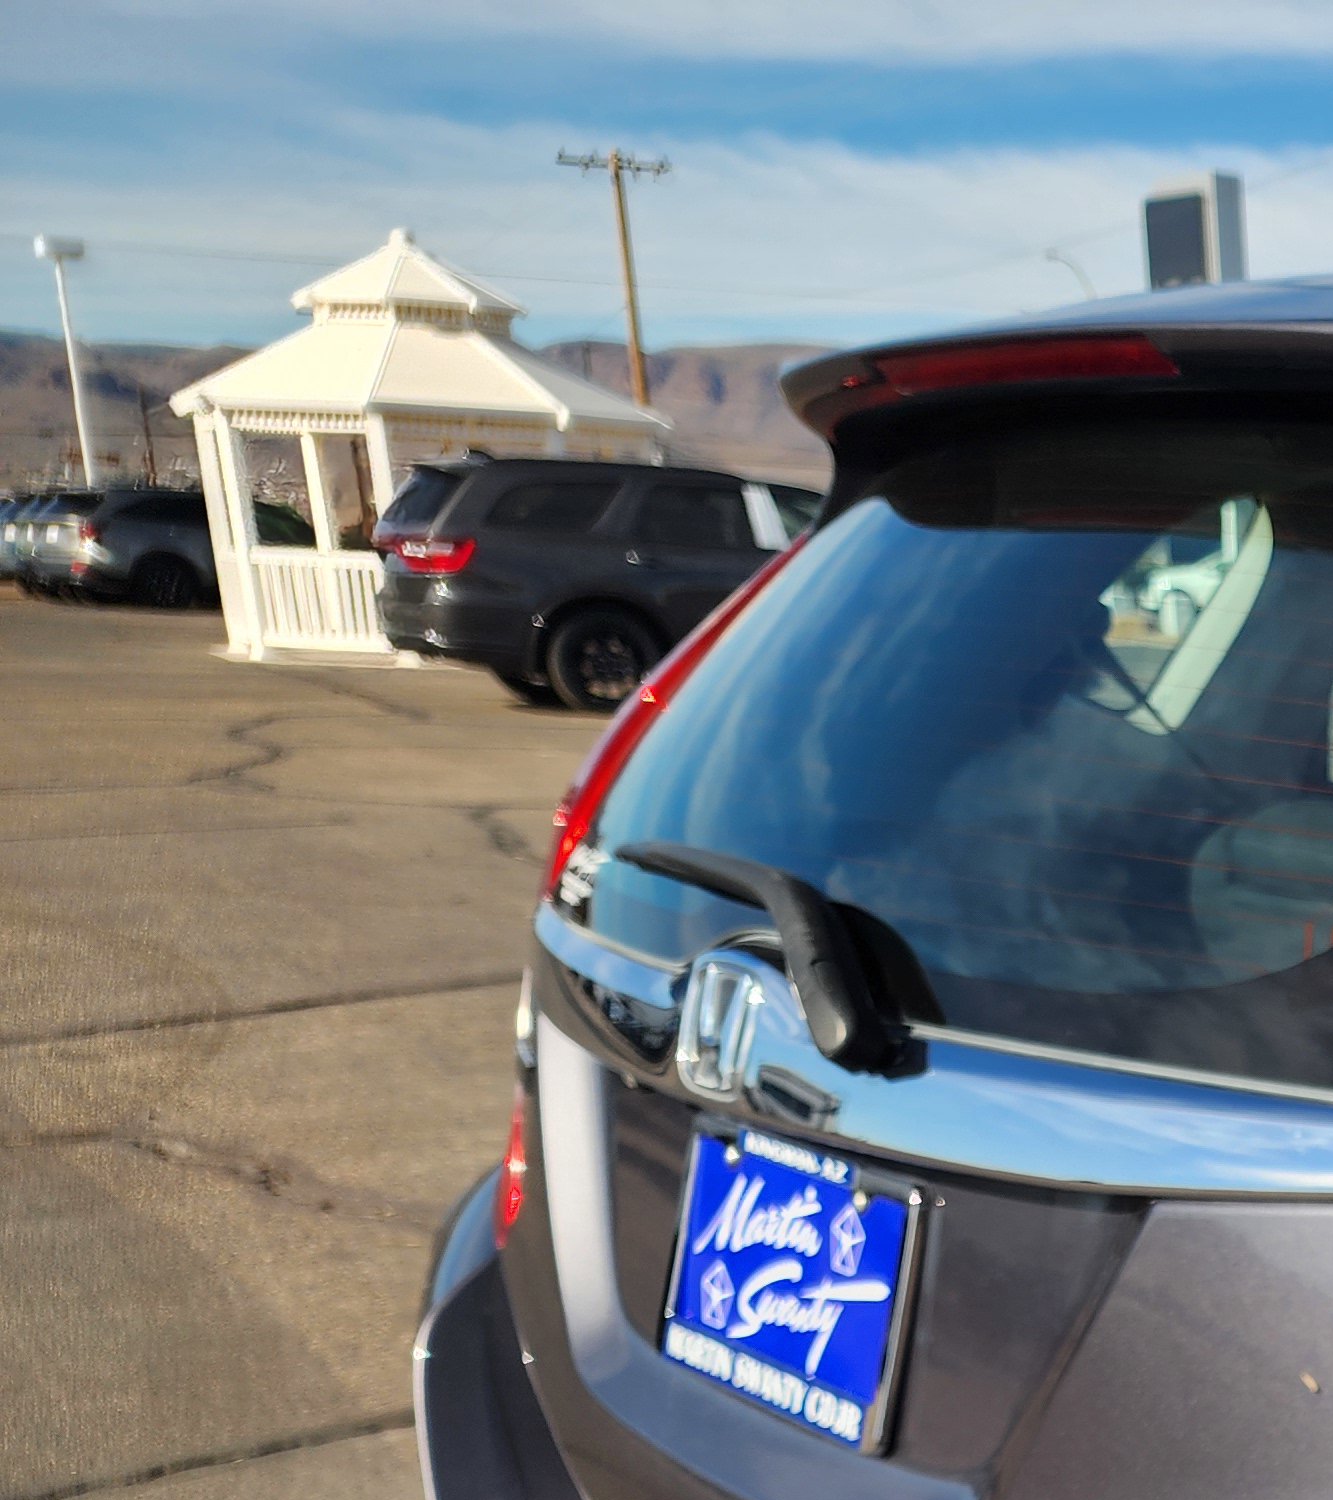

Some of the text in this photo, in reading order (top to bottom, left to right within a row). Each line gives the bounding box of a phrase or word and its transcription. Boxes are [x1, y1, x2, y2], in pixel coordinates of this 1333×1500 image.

[692, 1173, 823, 1258] Martin
[726, 1257, 891, 1381] Swanty
[666, 1322, 735, 1383] MARTIN
[731, 1350, 810, 1415] SWANTY
